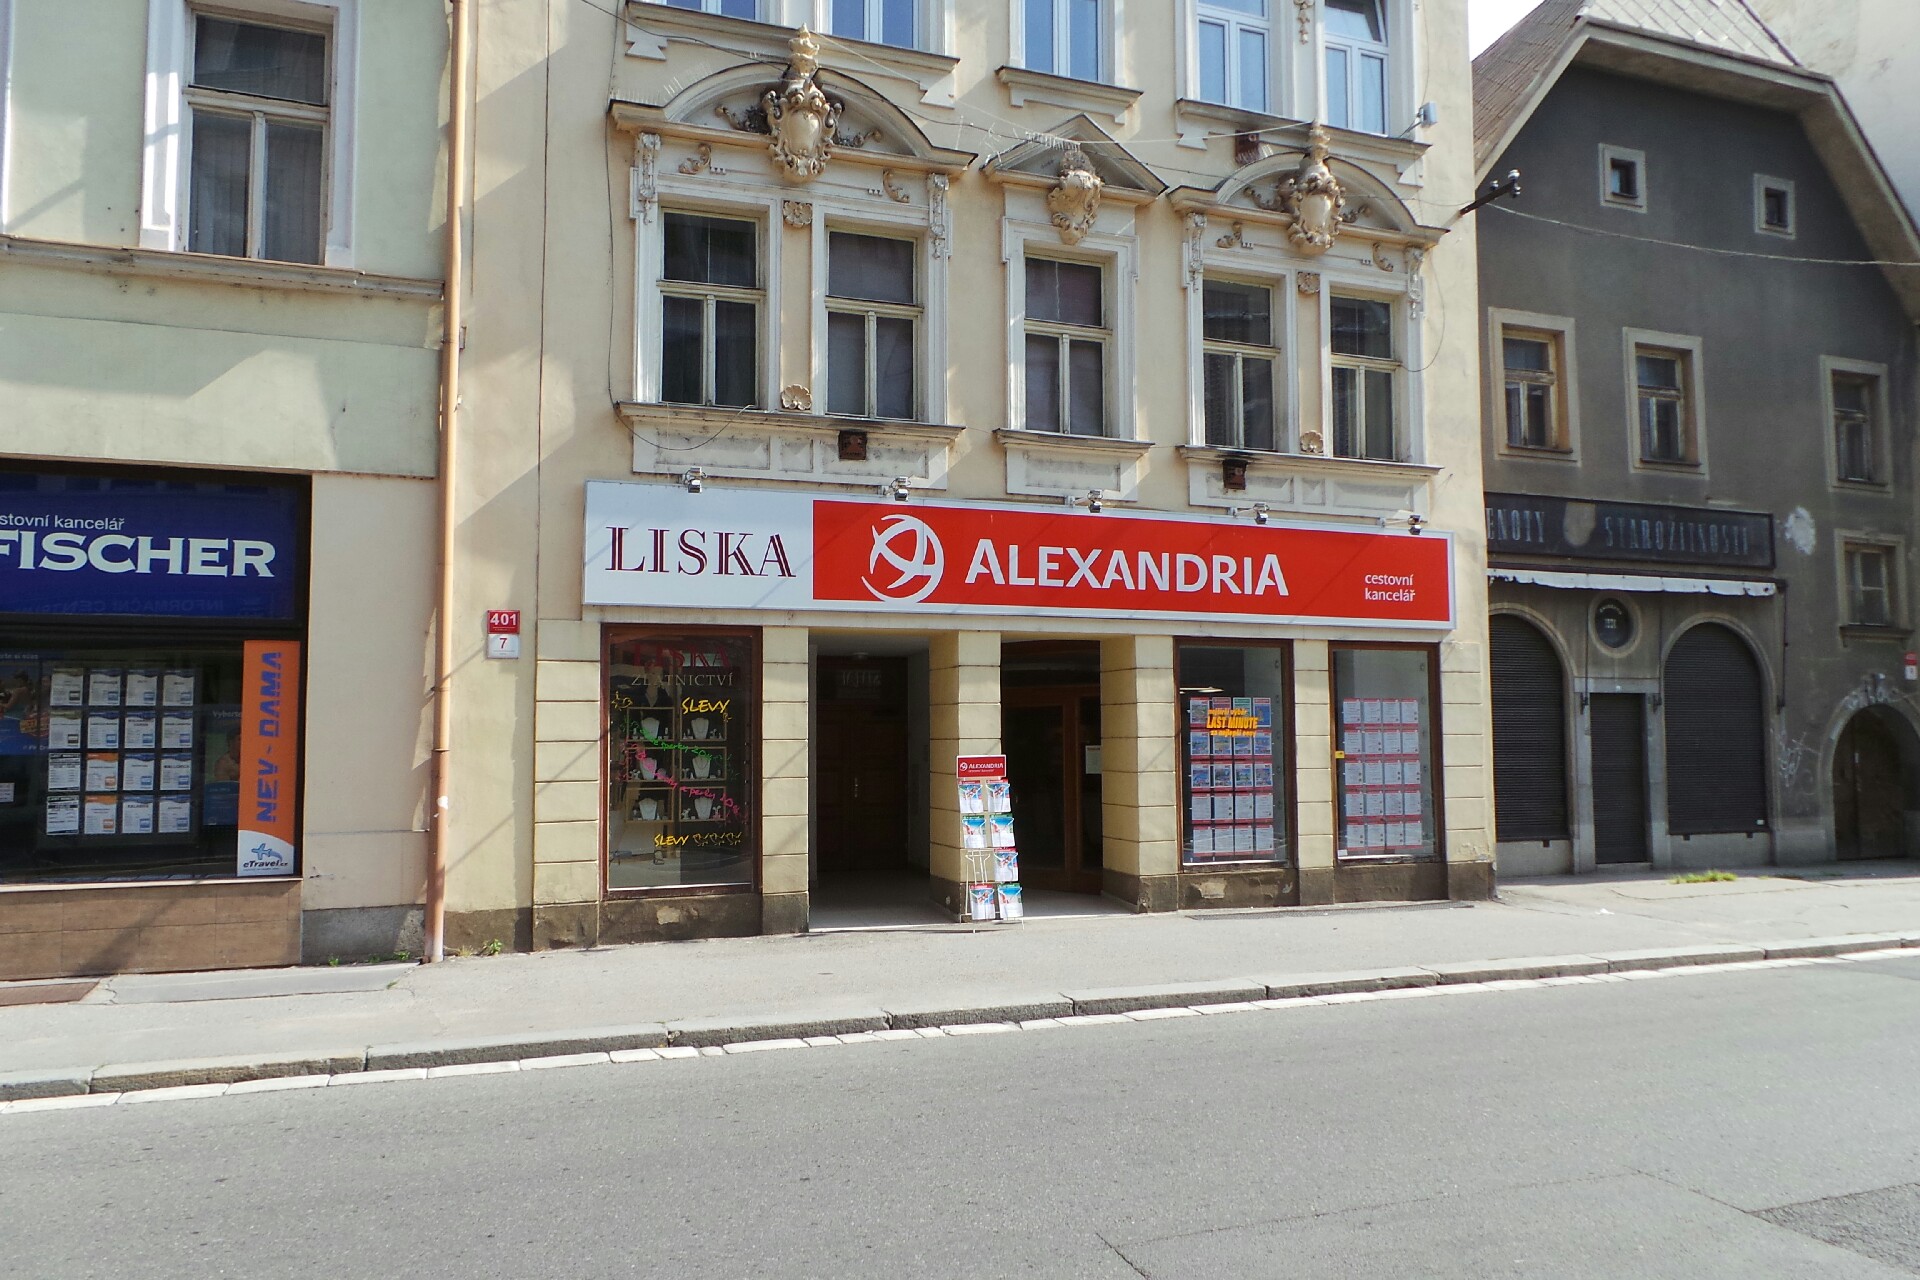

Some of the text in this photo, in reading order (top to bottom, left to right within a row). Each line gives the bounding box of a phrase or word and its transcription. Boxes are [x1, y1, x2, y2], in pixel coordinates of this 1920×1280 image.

[54, 515, 125, 530] kancelář
[605, 526, 797, 578] LISKA
[965, 538, 1289, 596] ALEXANDRIA
[1364, 574, 1414, 586] cestovní
[1364, 587, 1416, 602] kancelář
[490, 613, 517, 626] 401
[499, 637, 508, 649] 7
[682, 697, 730, 715] SLEVY
[1206, 716, 1258, 729] LAST MINUTE
[654, 833, 689, 847] SLEVY
